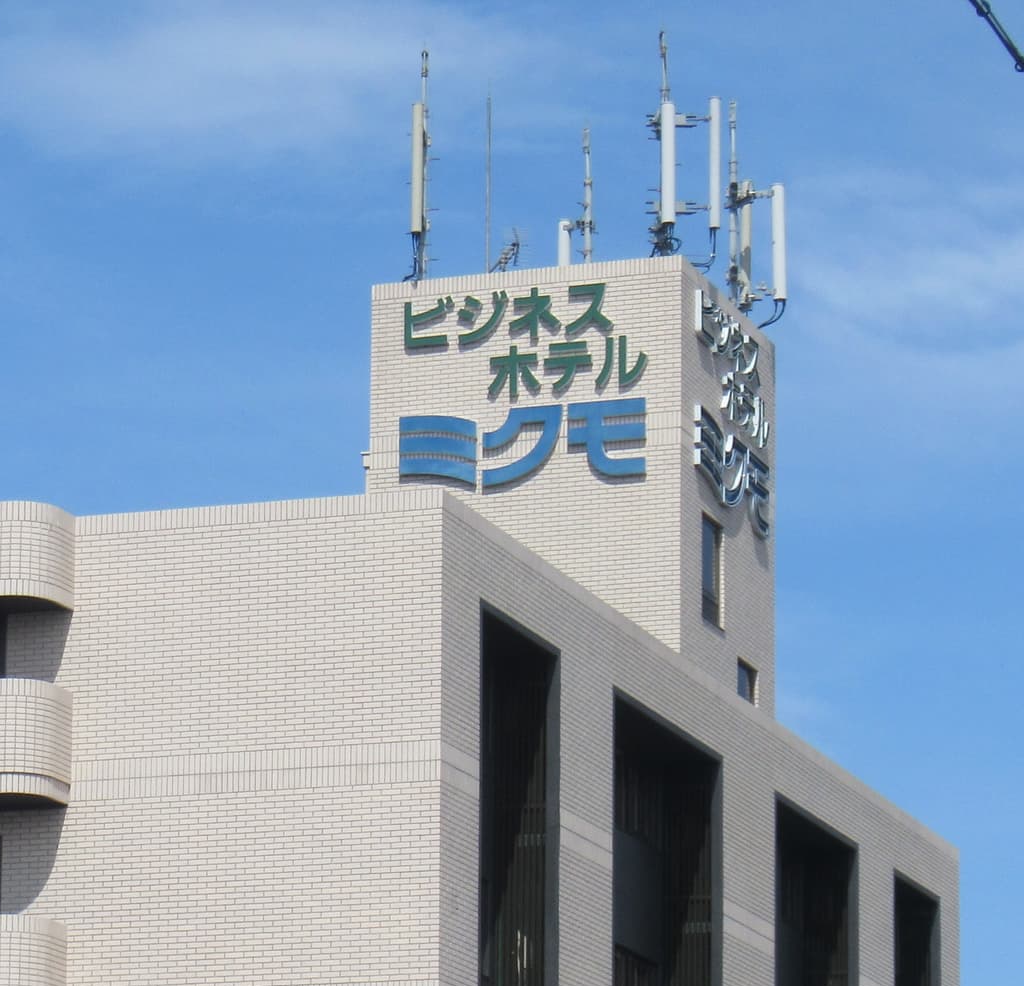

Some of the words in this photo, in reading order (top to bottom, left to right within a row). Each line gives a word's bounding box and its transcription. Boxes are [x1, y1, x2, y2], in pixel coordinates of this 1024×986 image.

[404, 282, 614, 348] ビジネス
[488, 335, 648, 399] ホテル
[399, 397, 647, 488] ミクモ
